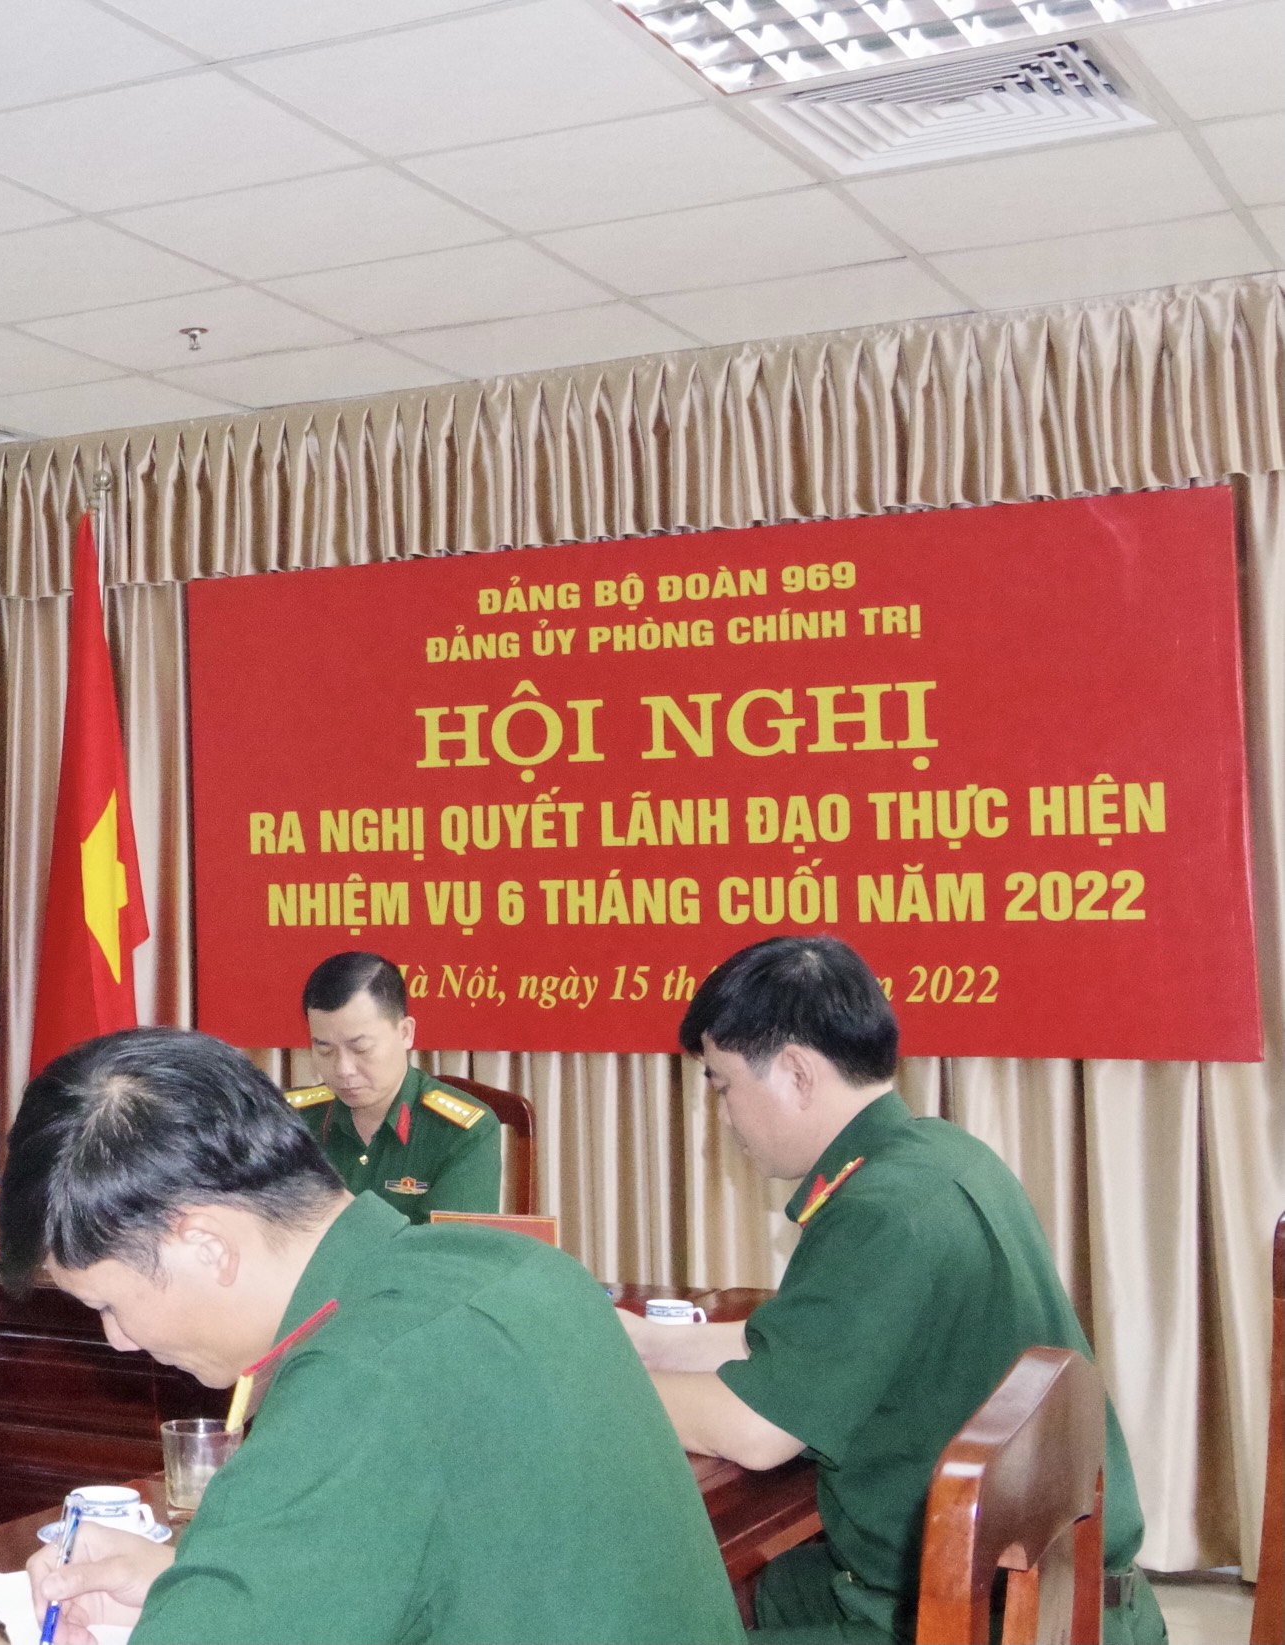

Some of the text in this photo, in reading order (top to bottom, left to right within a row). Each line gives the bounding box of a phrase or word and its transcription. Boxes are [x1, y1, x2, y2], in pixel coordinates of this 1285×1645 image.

[477, 561, 857, 615] ĐẢNG BỘ ĐOÀN 969
[425, 604, 922, 663] ĐẢNG ỦY PHÒNG CHÍNH TRỊ
[414, 679, 939, 783] HỘI NGHỊ
[249, 772, 1167, 861] RA NGHỊ QUYẾT LÃNH ĐẠO THỰC HIỆN
[267, 857, 1147, 936] NHIỆM VỤ 6 THÁNG CUỐI NĂM 2022
[436, 964, 506, 1008] Nội,
[518, 966, 599, 1009] ngày
[610, 965, 651, 1001] 15
[905, 965, 1000, 1004] 2022
